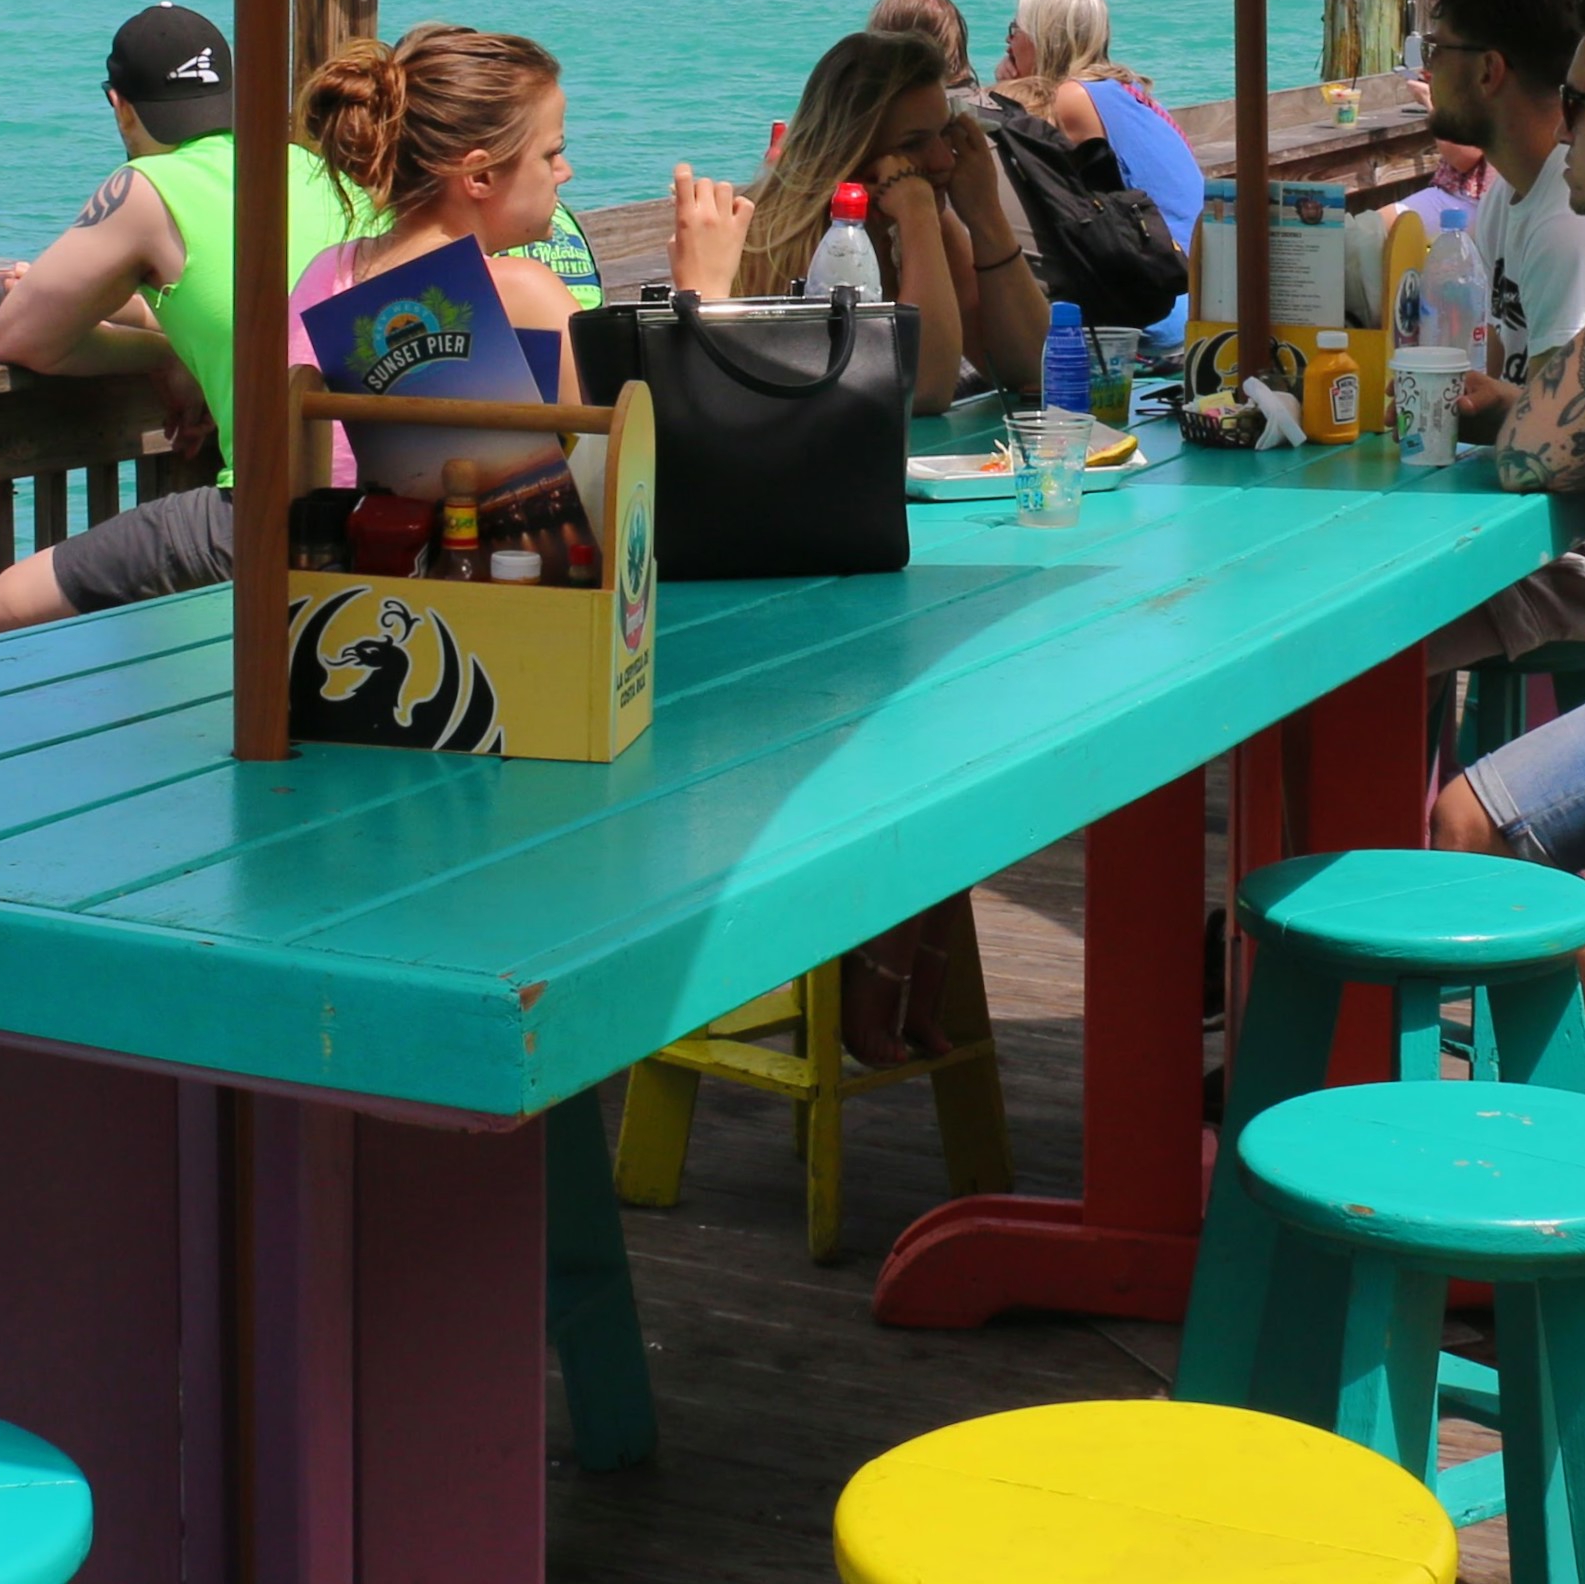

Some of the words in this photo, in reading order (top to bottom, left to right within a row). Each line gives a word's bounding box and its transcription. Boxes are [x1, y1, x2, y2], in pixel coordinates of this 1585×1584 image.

[392, 302, 430, 318] WEST
[367, 341, 421, 389] SUNSET
[426, 334, 465, 354] PIER
